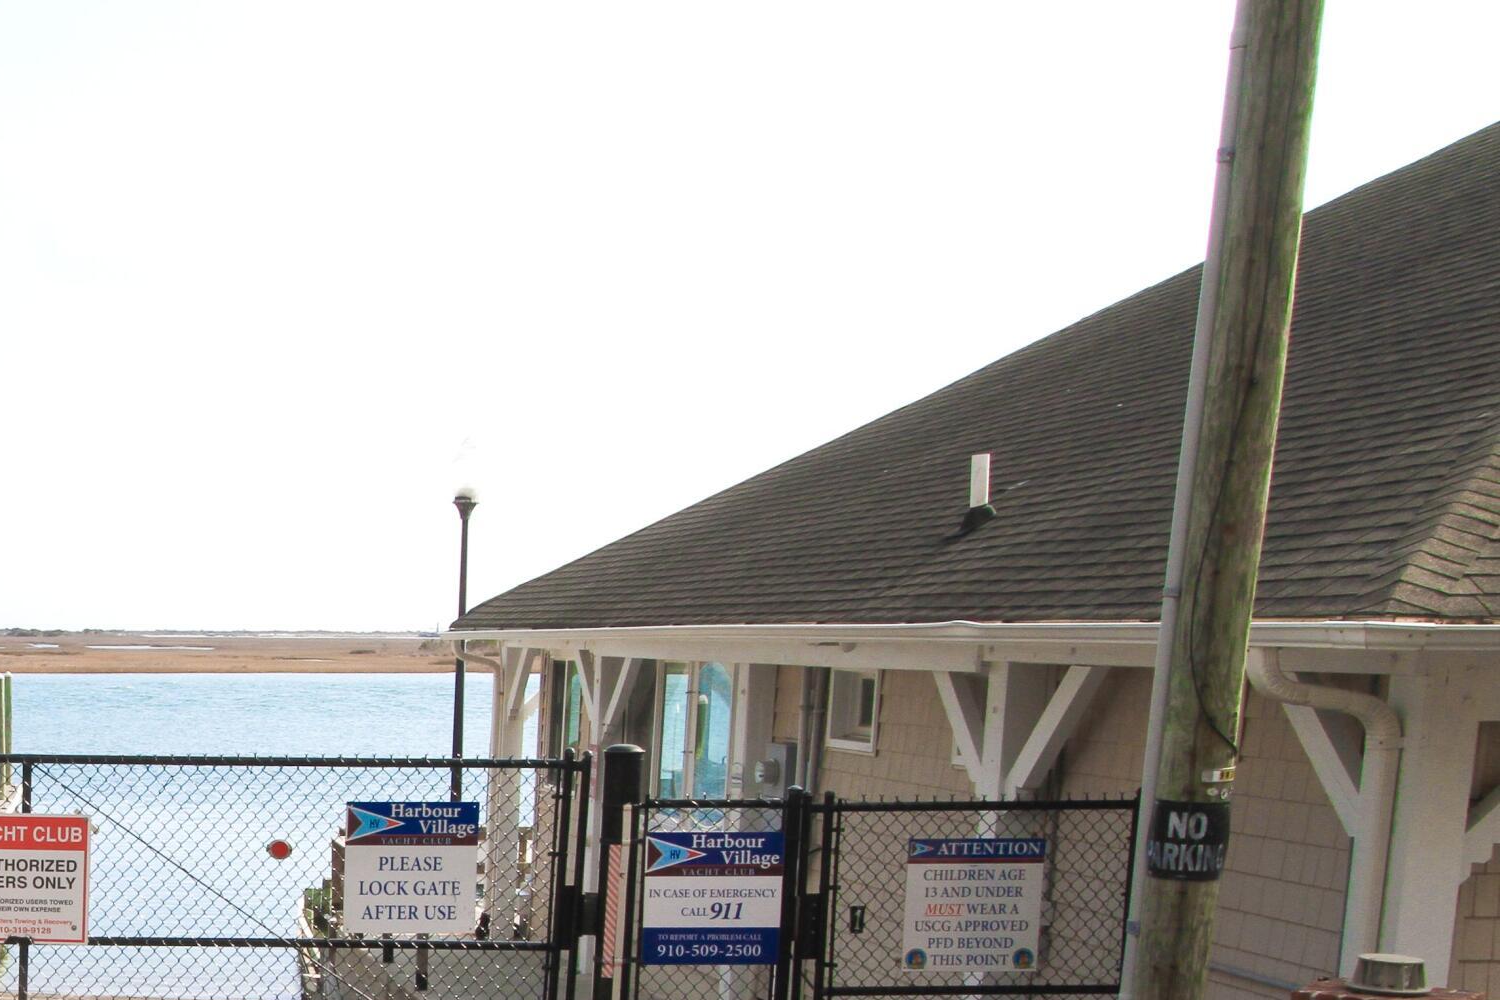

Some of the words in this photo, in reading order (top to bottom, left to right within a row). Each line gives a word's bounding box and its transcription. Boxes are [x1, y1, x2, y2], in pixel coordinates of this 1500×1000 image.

[391, 804, 461, 818] Harbour
[420, 820, 476, 838] Village
[1168, 811, 1208, 840] NO
[32, 826, 83, 842] CLUB
[692, 834, 765, 848] Harbour
[670, 850, 681, 860] HV
[938, 842, 1041, 856] ATTENTION
[378, 856, 442, 871] PLEASE
[720, 851, 780, 868] Village
[682, 868, 719, 876] YACHT
[924, 869, 996, 881] CHILDREN
[998, 869, 1026, 880] AGE
[32, 876, 76, 890] ONLY
[359, 880, 409, 896] LOCK
[413, 880, 461, 896] GATE
[649, 888, 662, 898] IN
[664, 888, 690, 898] CASE
[692, 888, 707, 898] OF
[710, 888, 778, 898] EMERGENCY
[924, 887, 938, 898] 13
[940, 886, 972, 898] AND
[976, 886, 1023, 898] UNDER
[361, 906, 419, 920] AFTER
[424, 906, 457, 920] USE
[681, 907, 708, 916] CALL
[710, 902, 743, 920] 911
[924, 904, 964, 915] MUST
[966, 904, 1007, 914] WEAR
[1010, 904, 1020, 914] A
[44, 919, 74, 927] Recovery
[914, 921, 952, 932] USCG
[954, 920, 1029, 932] APPROVED
[928, 938, 954, 949] PFD
[958, 937, 1014, 949] BEYOND
[657, 944, 762, 958] 910-509-2500
[930, 954, 962, 966] THIS
[966, 954, 1010, 966] POINT
